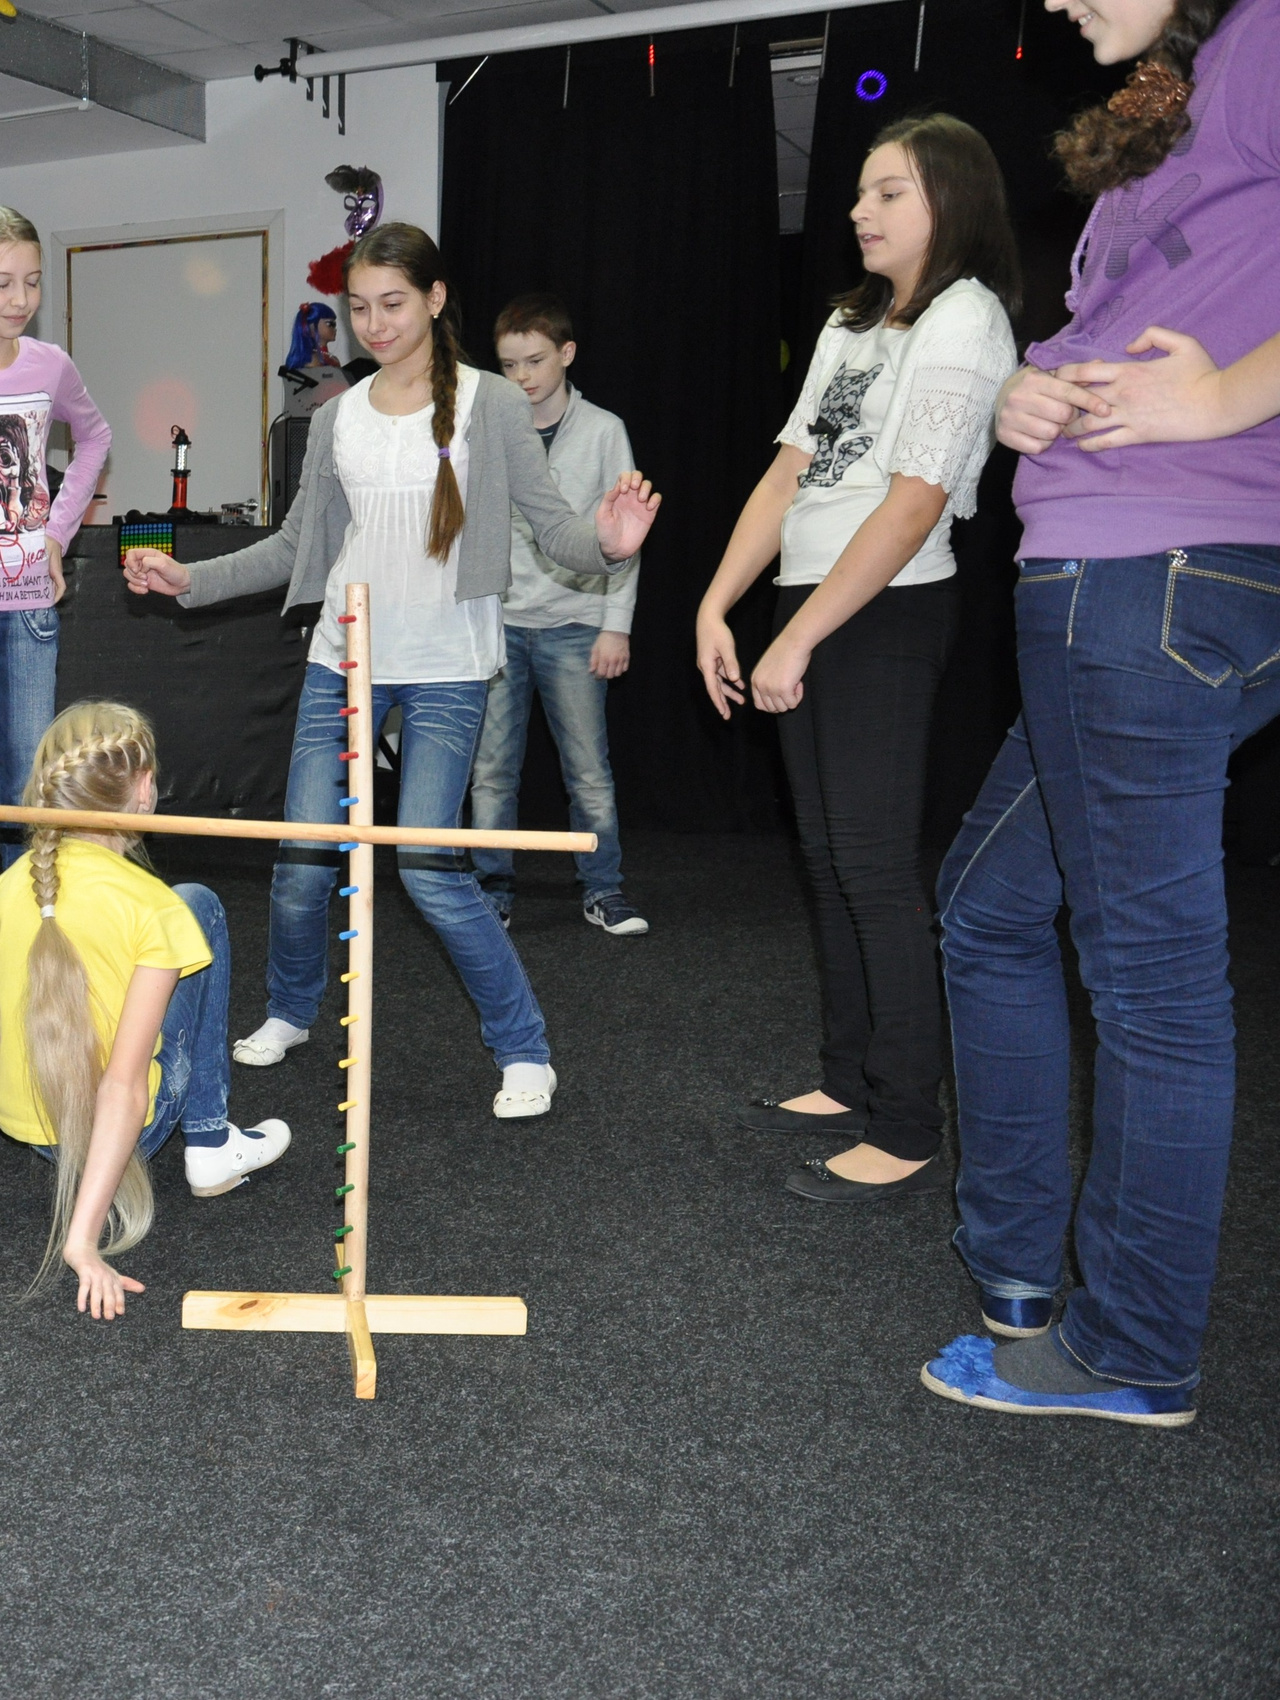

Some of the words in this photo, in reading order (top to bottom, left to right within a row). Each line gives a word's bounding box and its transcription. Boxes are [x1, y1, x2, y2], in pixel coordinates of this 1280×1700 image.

[2, 576, 22, 588] STILL
[22, 575, 42, 587] WANT
[5, 591, 13, 601] IN
[13, 591, 20, 601] A
